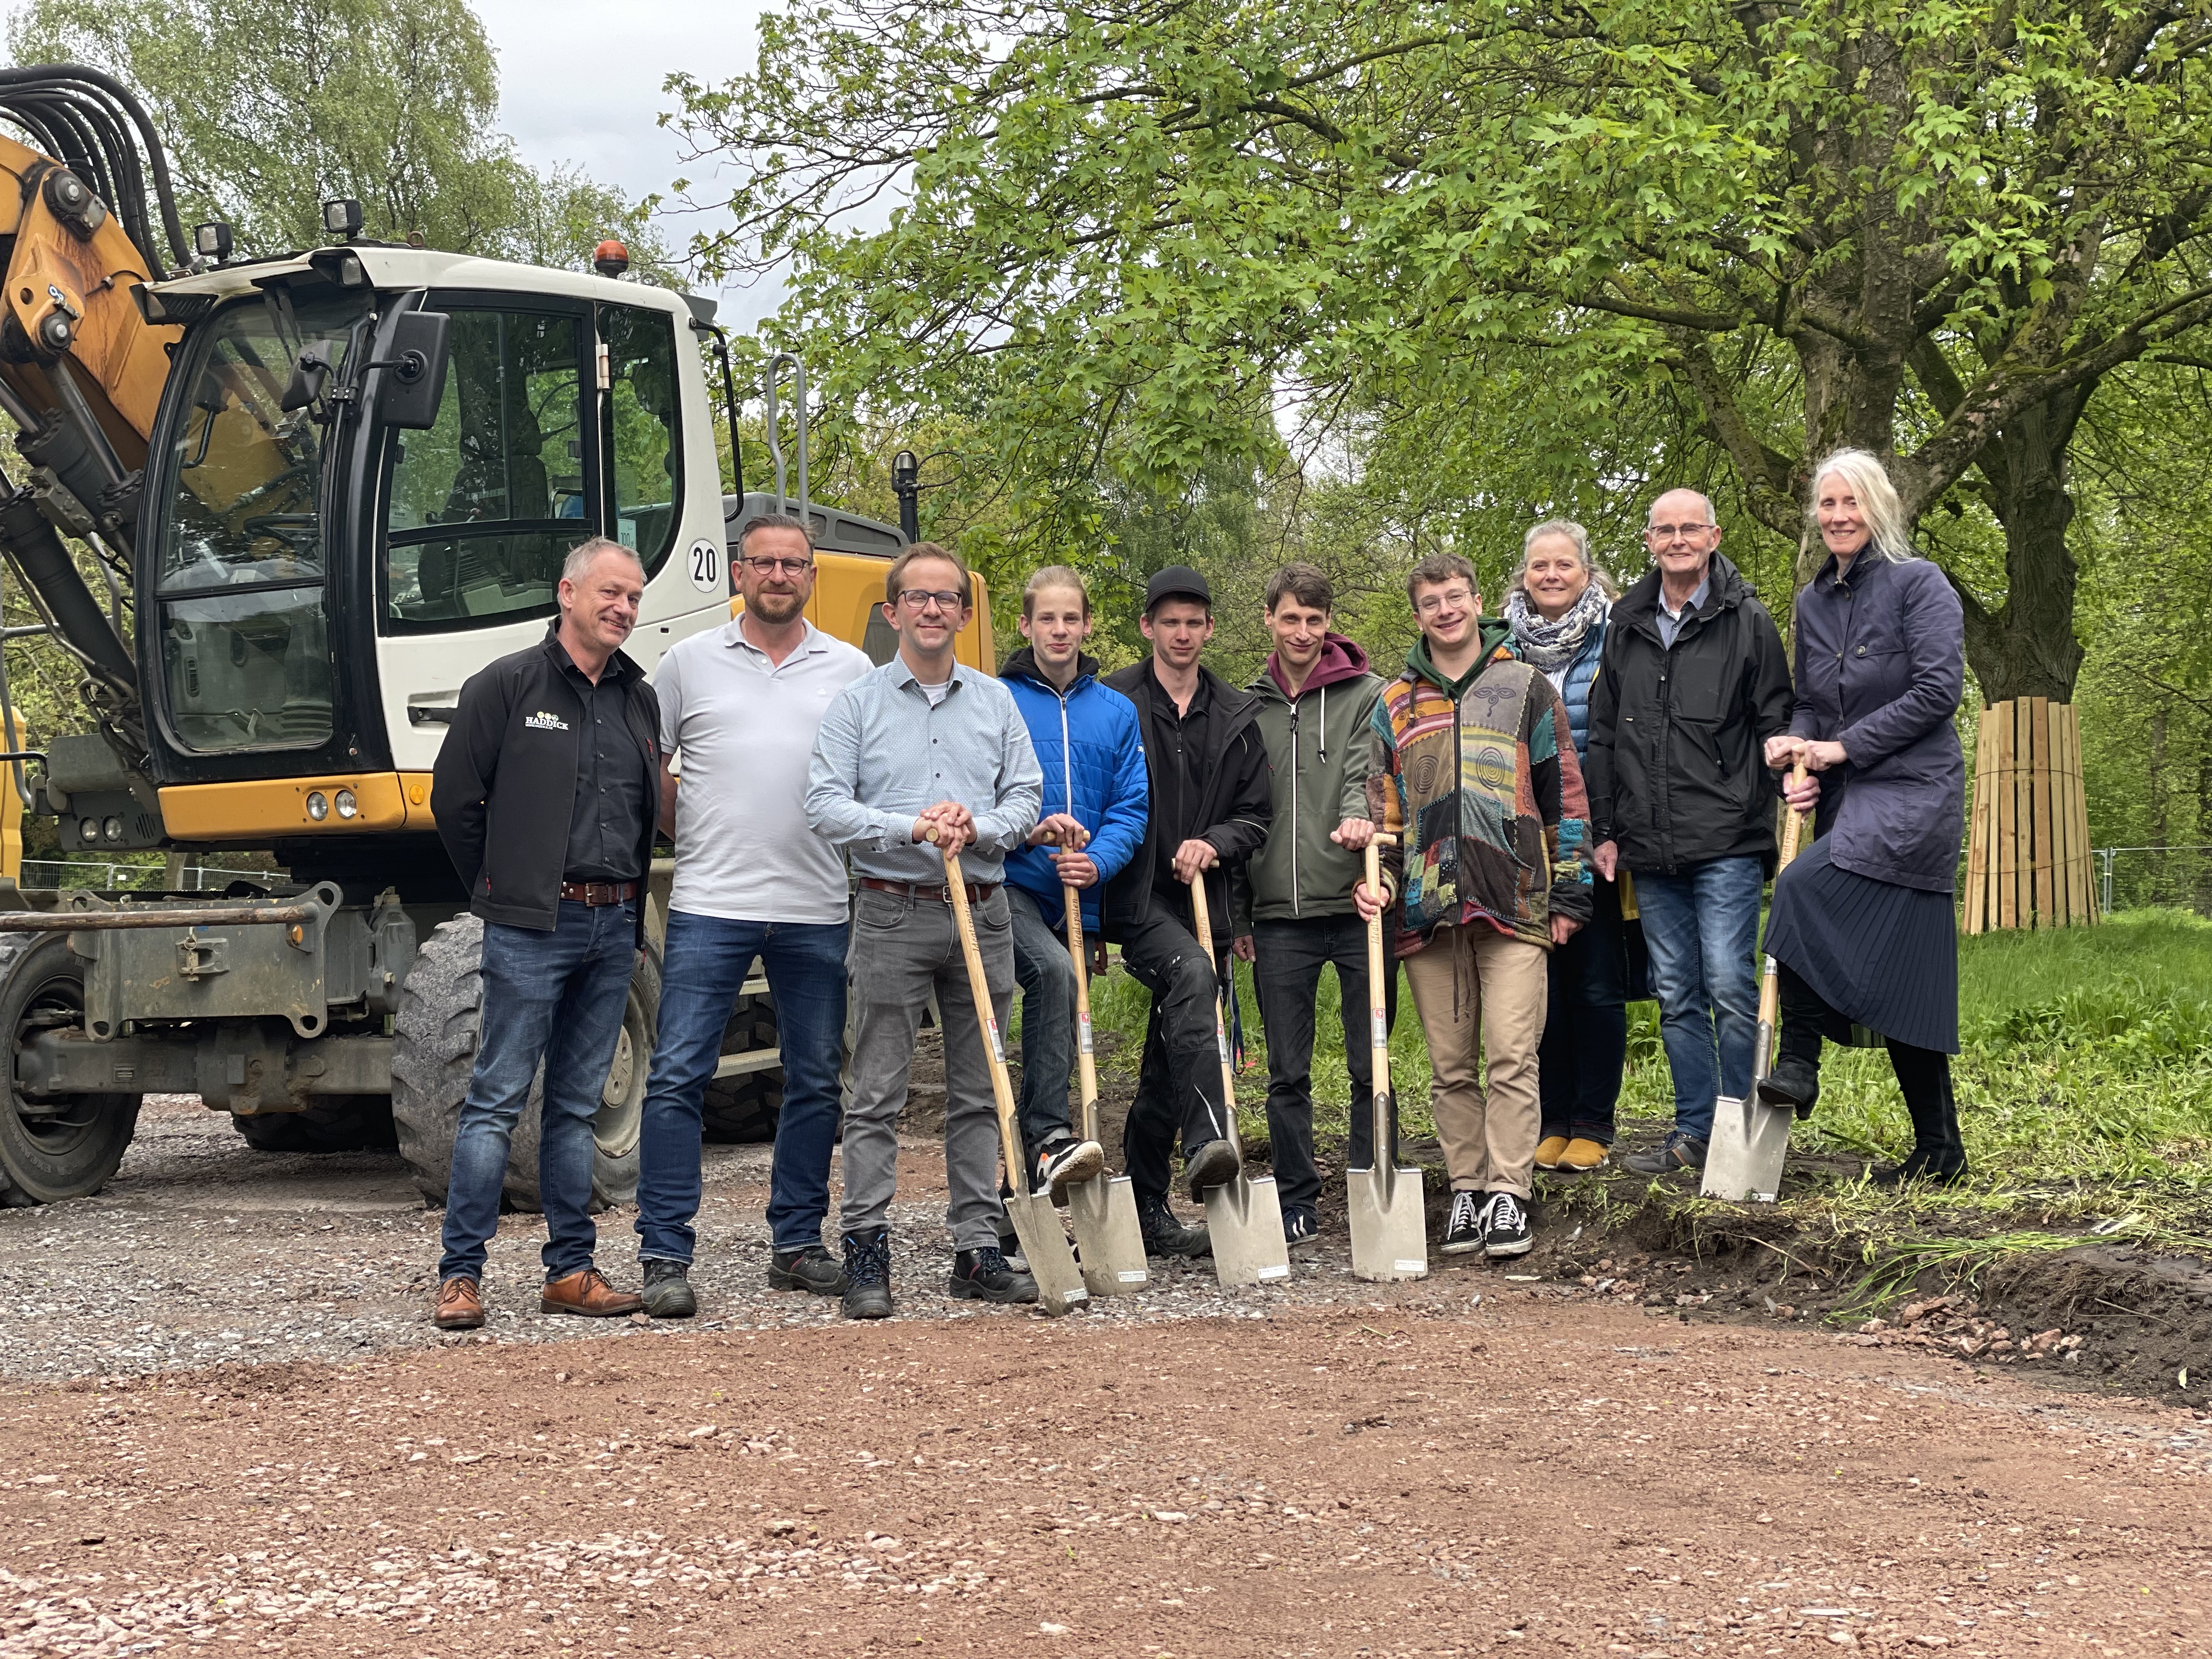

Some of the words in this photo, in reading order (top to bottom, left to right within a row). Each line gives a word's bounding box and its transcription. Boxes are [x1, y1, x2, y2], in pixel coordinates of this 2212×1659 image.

[620, 532, 630, 546] 100
[693, 546, 716, 583] 20
[525, 716, 569, 730] HADDICK
[1781, 816, 1795, 865] Idealspaten
[1072, 899, 1082, 949] Idealspaten
